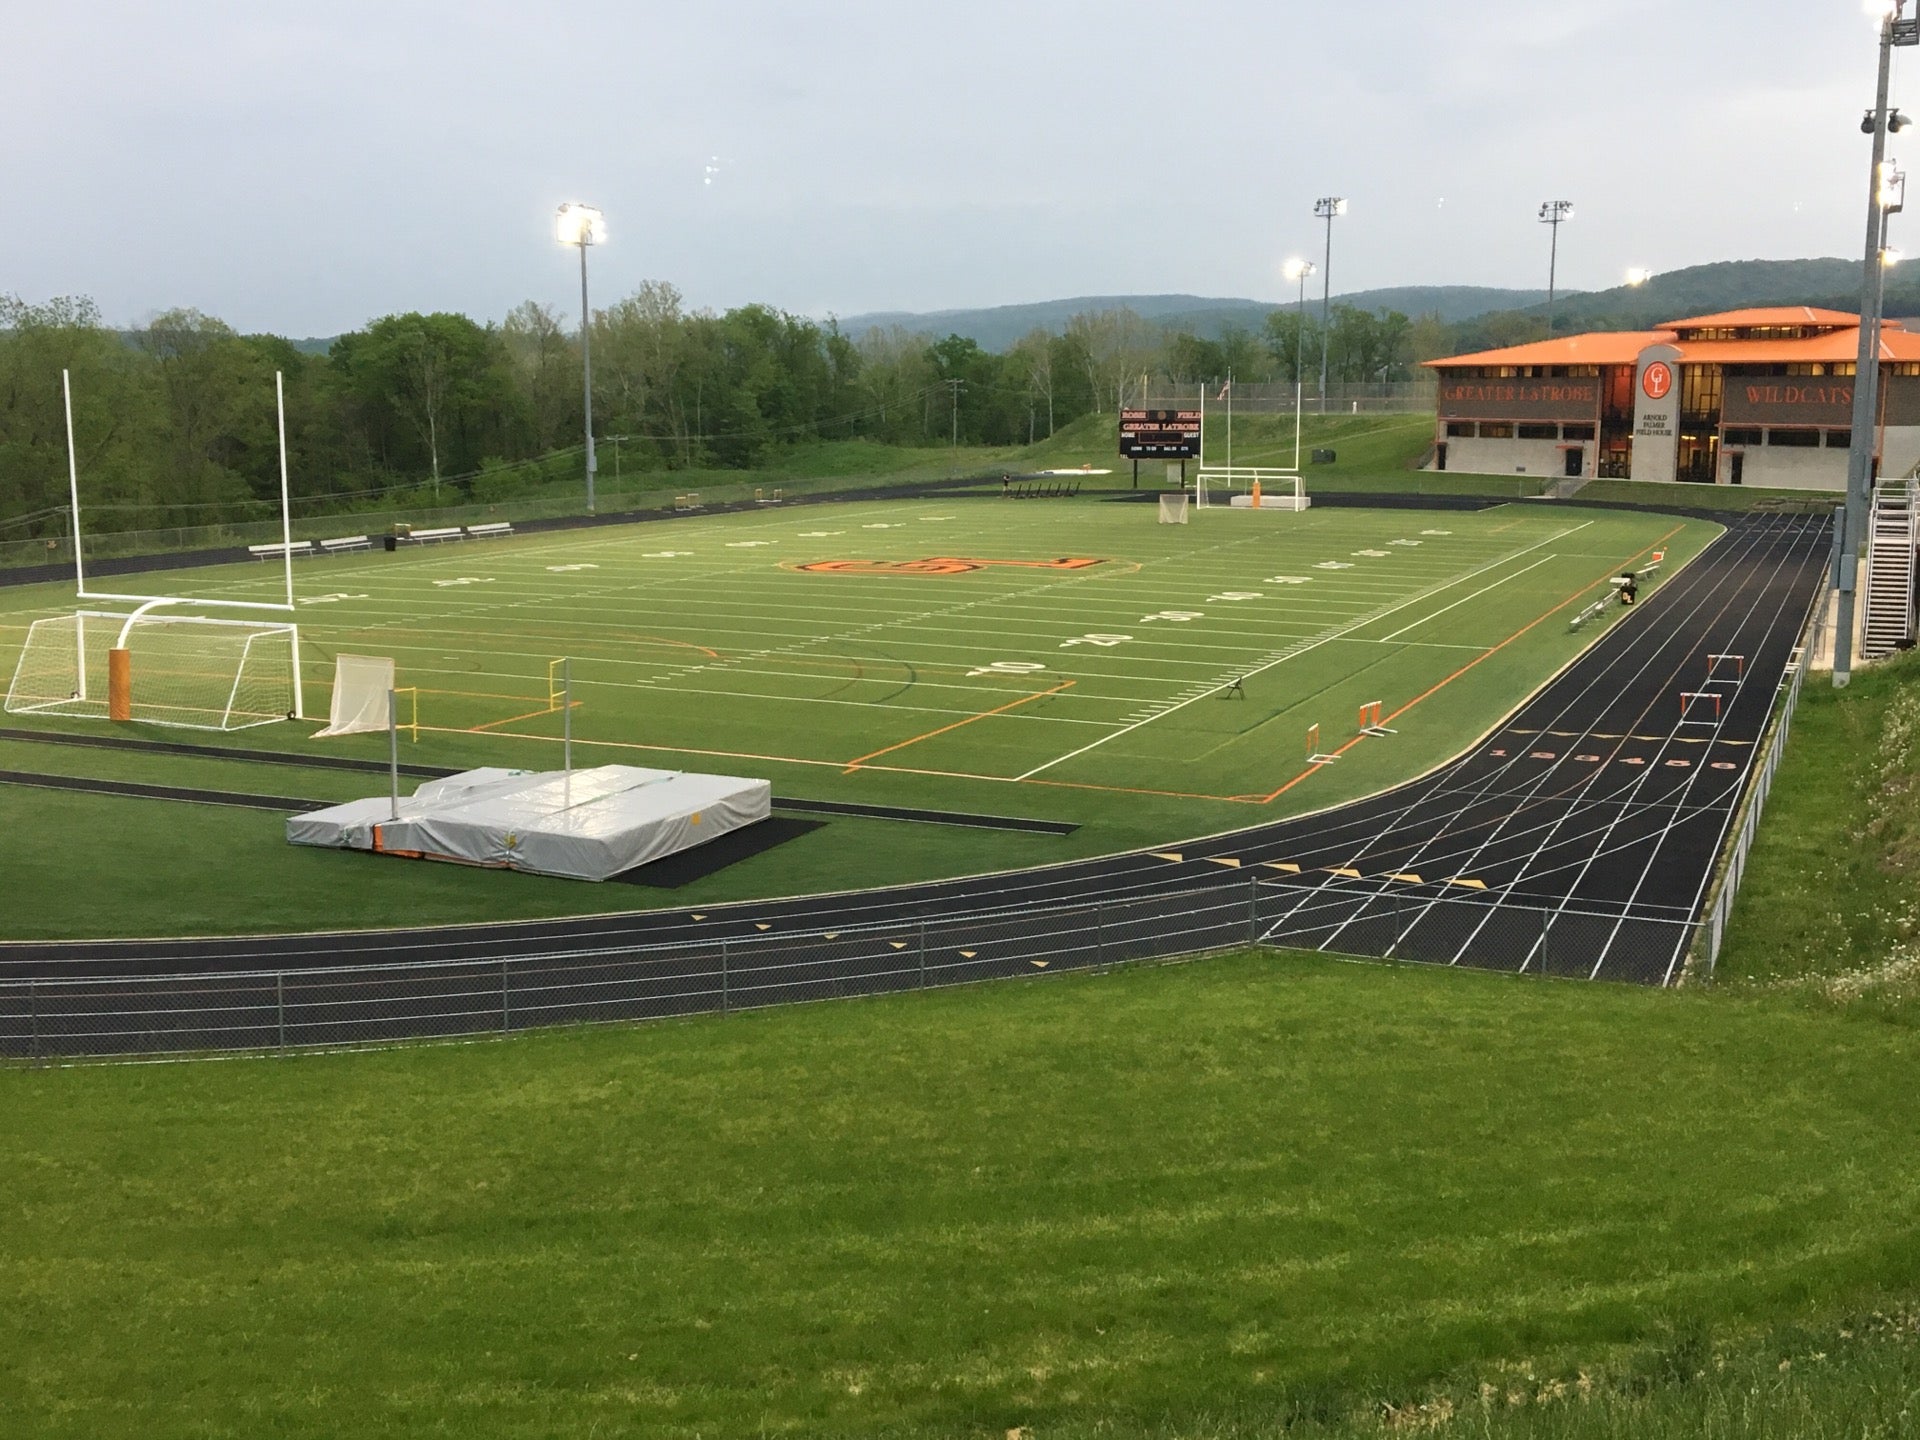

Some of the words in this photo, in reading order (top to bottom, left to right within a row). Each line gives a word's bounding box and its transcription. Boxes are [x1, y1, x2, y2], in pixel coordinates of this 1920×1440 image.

[1444, 385, 1514, 401] GREATER
[1746, 386, 1853, 405] WILDCATS
[1177, 411, 1201, 419] FIELD
[1123, 423, 1160, 431] GREATER
[1162, 423, 1199, 431] LATROBE
[1065, 633, 1134, 647] 20
[973, 661, 1046, 675] 10
[1489, 749, 1507, 757] 1
[1529, 751, 1556, 759] 2
[1573, 754, 1600, 762] 3
[1618, 757, 1645, 765] 4
[1664, 759, 1691, 767] 5
[1710, 762, 1737, 770] 6
